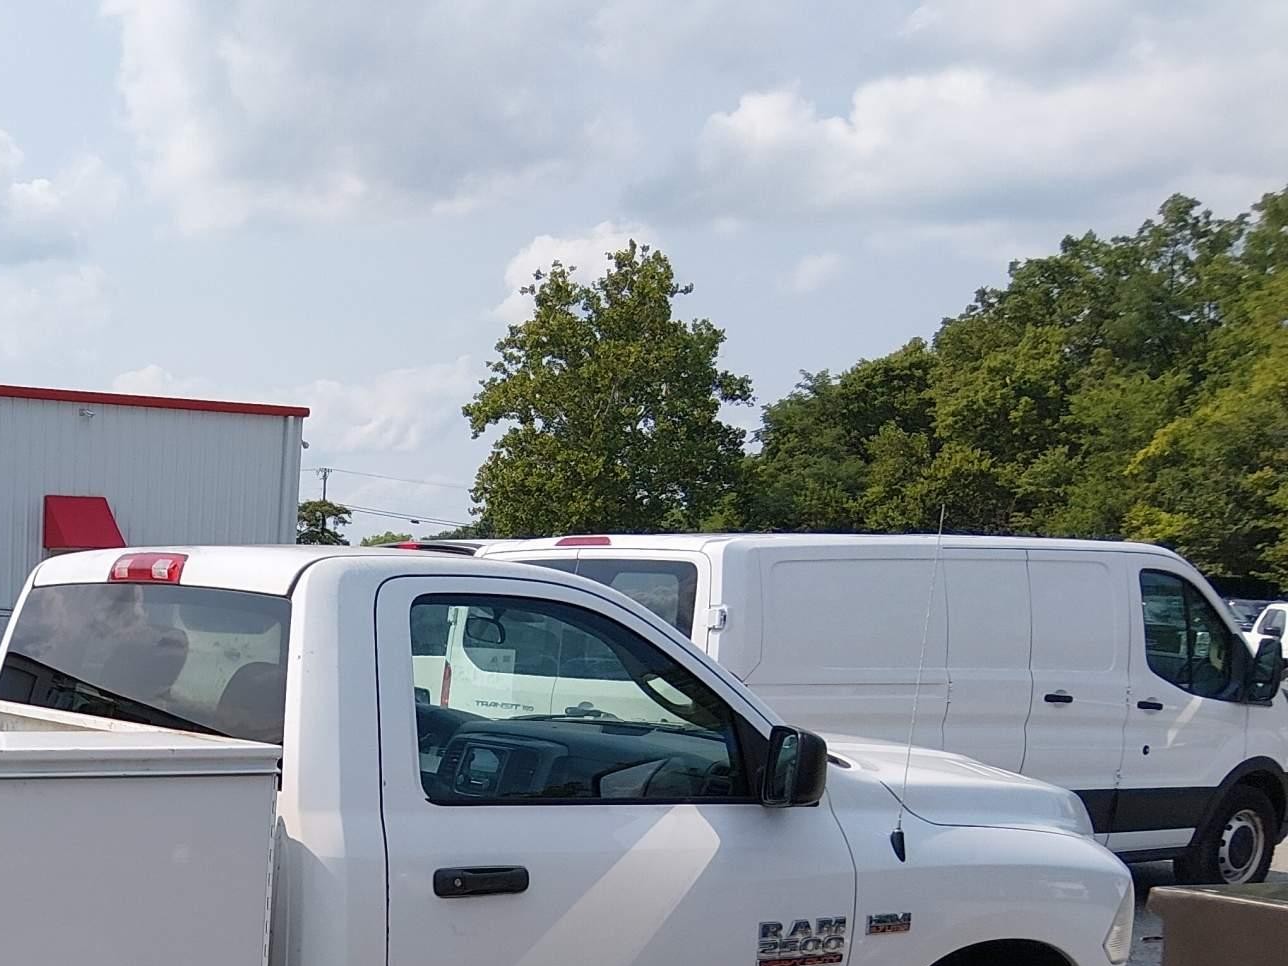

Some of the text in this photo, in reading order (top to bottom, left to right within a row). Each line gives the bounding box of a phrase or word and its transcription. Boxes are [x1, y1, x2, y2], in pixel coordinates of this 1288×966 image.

[475, 700, 520, 710] TRANSIT
[758, 916, 847, 939] RAM
[757, 934, 845, 954] 2500
